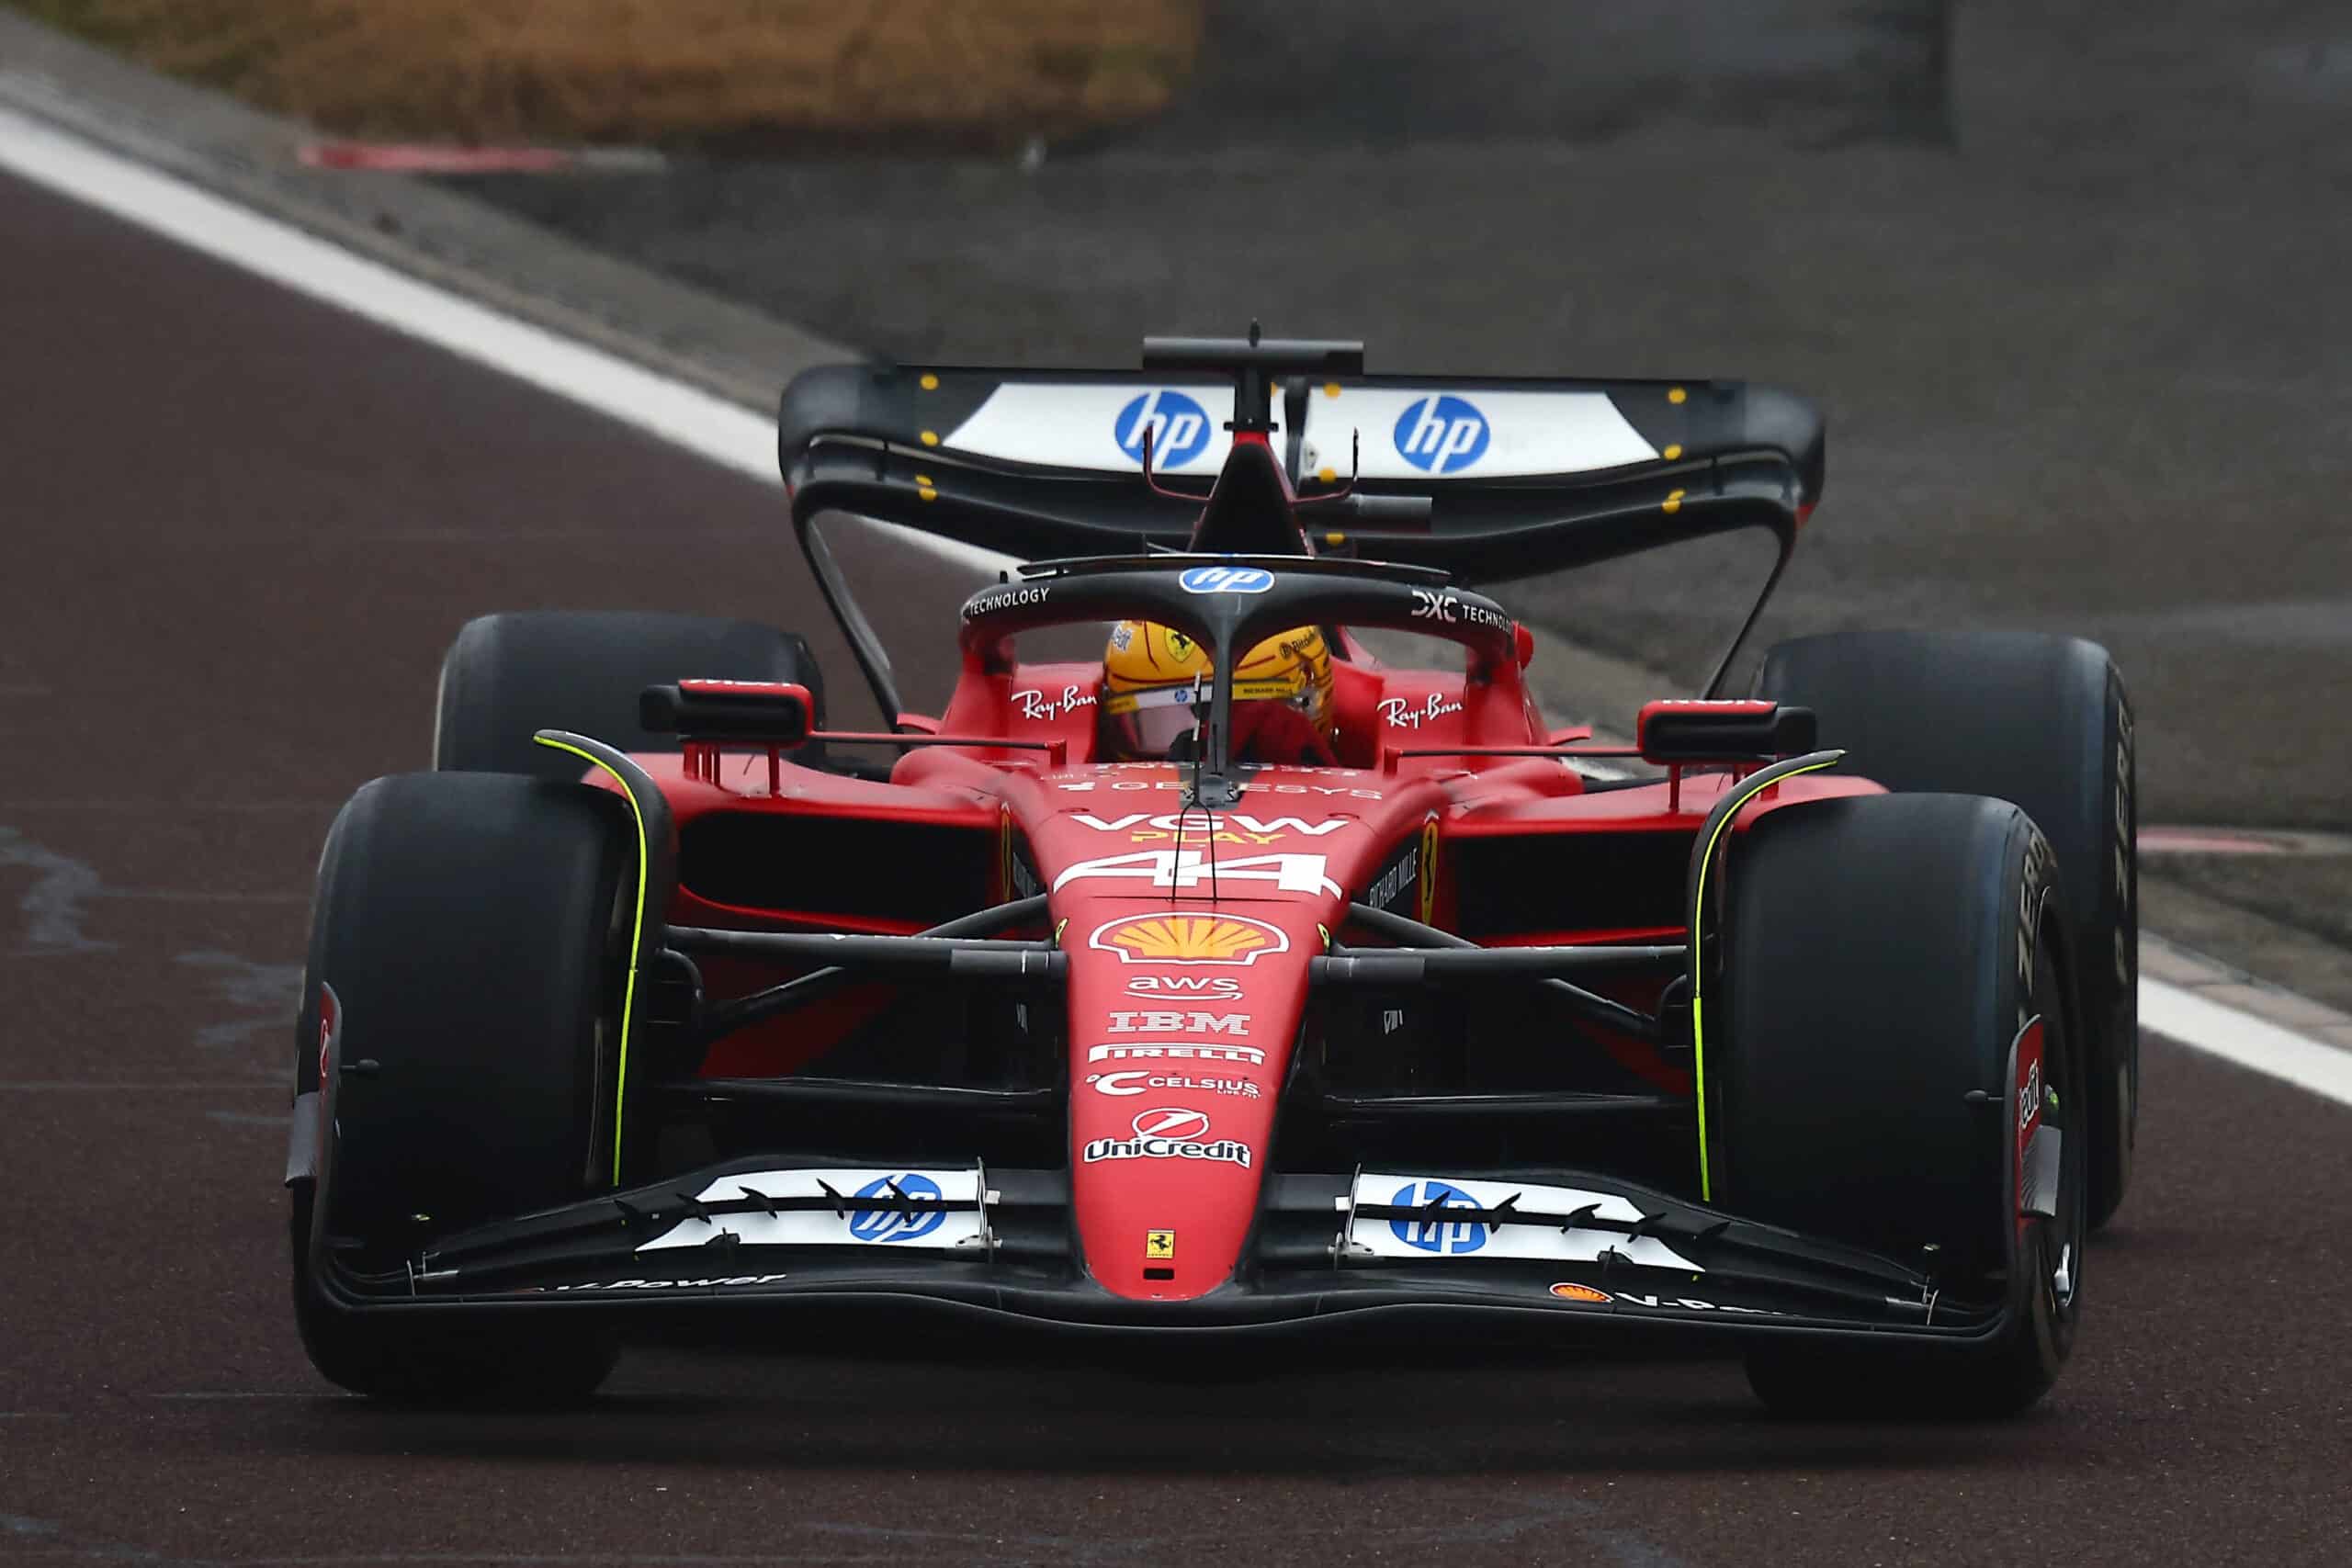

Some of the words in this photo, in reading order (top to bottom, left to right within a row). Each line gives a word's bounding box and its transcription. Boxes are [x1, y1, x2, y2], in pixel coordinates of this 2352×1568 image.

[1123, 389, 1204, 470] hp
[1402, 394, 1483, 472] hp
[1191, 566, 1266, 592] hp
[969, 587, 1050, 617] TECHNOLOGY
[1410, 589, 1459, 624] DXC
[1462, 604, 1512, 634] TECHNOL
[1010, 684, 1098, 721] Ray-Ban
[1375, 693, 1464, 729] Ray-Ban
[1111, 780, 1383, 800] GEESYS
[1069, 813, 1351, 836] VGW
[1131, 830, 1287, 845] PLAY
[1052, 850, 1343, 901] 44
[1126, 975, 1241, 993] aws
[1106, 1010, 1251, 1036] IBM
[1088, 1042, 1267, 1066] PIRELLI
[1148, 1076, 1260, 1095] CELSIUS
[1083, 1138, 1251, 1169] UniCredit
